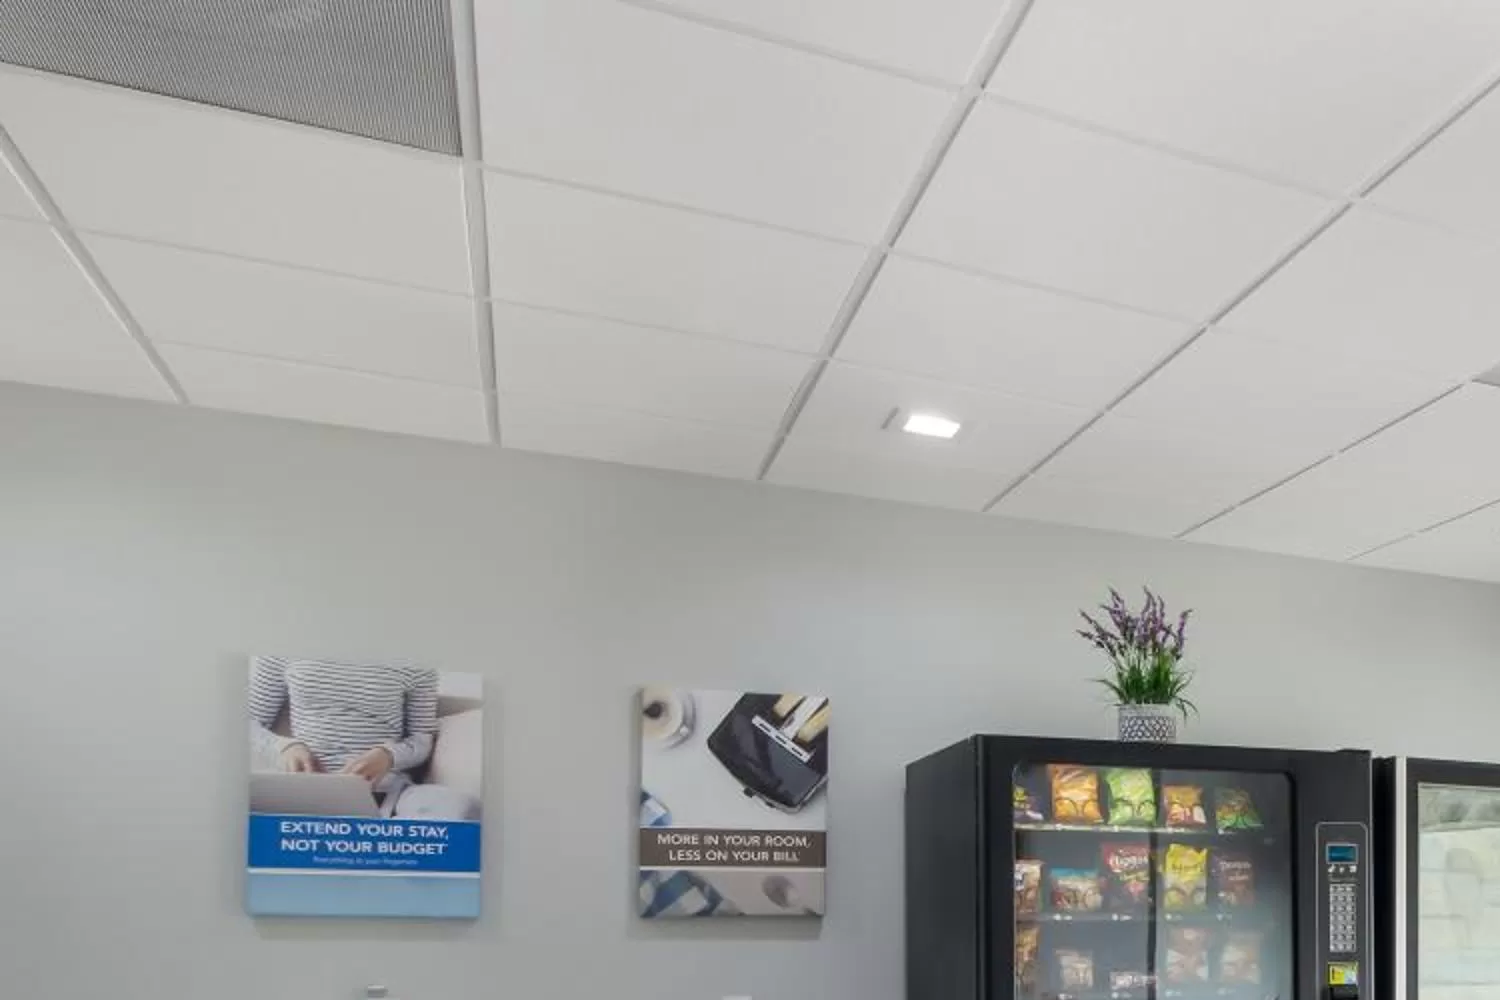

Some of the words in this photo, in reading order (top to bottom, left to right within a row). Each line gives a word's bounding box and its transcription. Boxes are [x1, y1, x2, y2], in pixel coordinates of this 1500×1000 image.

[280, 821, 351, 836] EXTEND
[357, 823, 404, 837] YOUR
[408, 825, 449, 840] STAY,
[280, 838, 321, 851] NOT
[325, 840, 373, 853] YOUR
[377, 841, 446, 855] BUDGET
[657, 833, 699, 846] MORE
[703, 835, 719, 846] IN
[723, 835, 761, 847] YOUR
[765, 836, 812, 849] ROOM,
[668, 849, 700, 861] LESS
[705, 850, 728, 862] ON
[732, 850, 769, 862] YOUR
[773, 851, 800, 863] BILL
